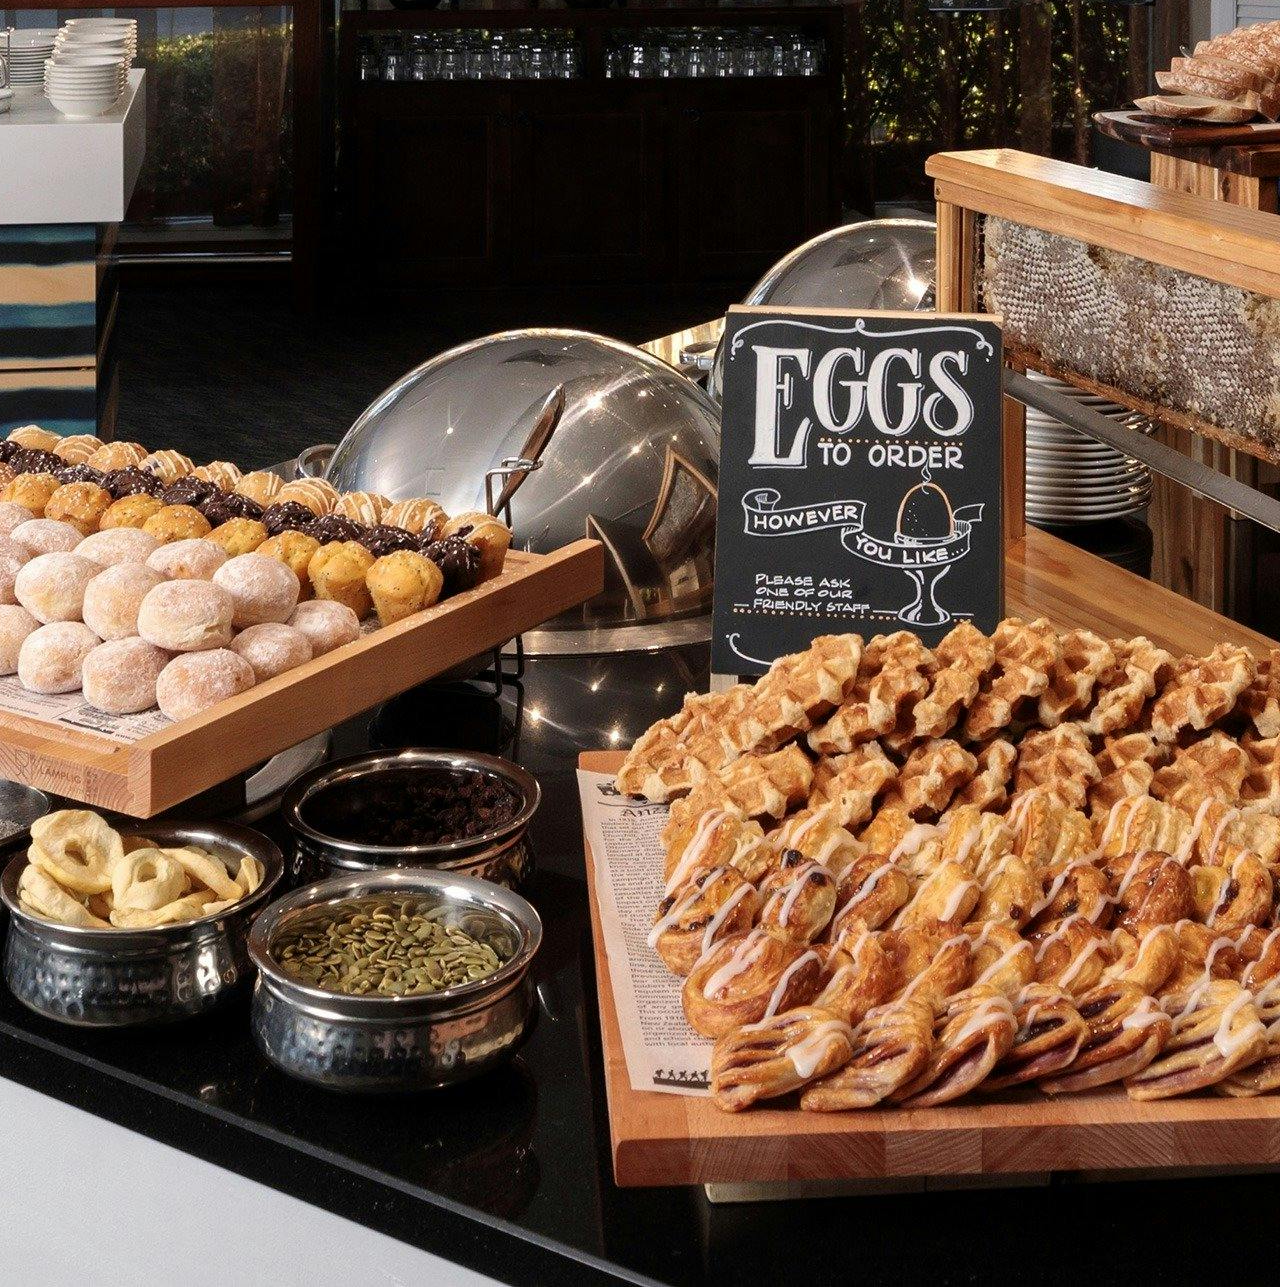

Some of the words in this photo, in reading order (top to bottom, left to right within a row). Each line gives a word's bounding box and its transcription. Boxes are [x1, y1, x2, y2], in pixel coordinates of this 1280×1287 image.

[748, 345, 975, 469] EGGS
[818, 443, 851, 466] TO
[868, 444, 964, 469] ORDER
[754, 504, 859, 530] HOWEVER
[855, 534, 891, 561] YOU
[755, 573, 813, 587] PLEASE
[819, 577, 851, 588] ASK
[755, 586, 790, 597] ONE
[794, 587, 818, 598] OF
[819, 588, 852, 599] OUR
[754, 599, 821, 612] FRIENDLY
[826, 602, 870, 614] STAFF
